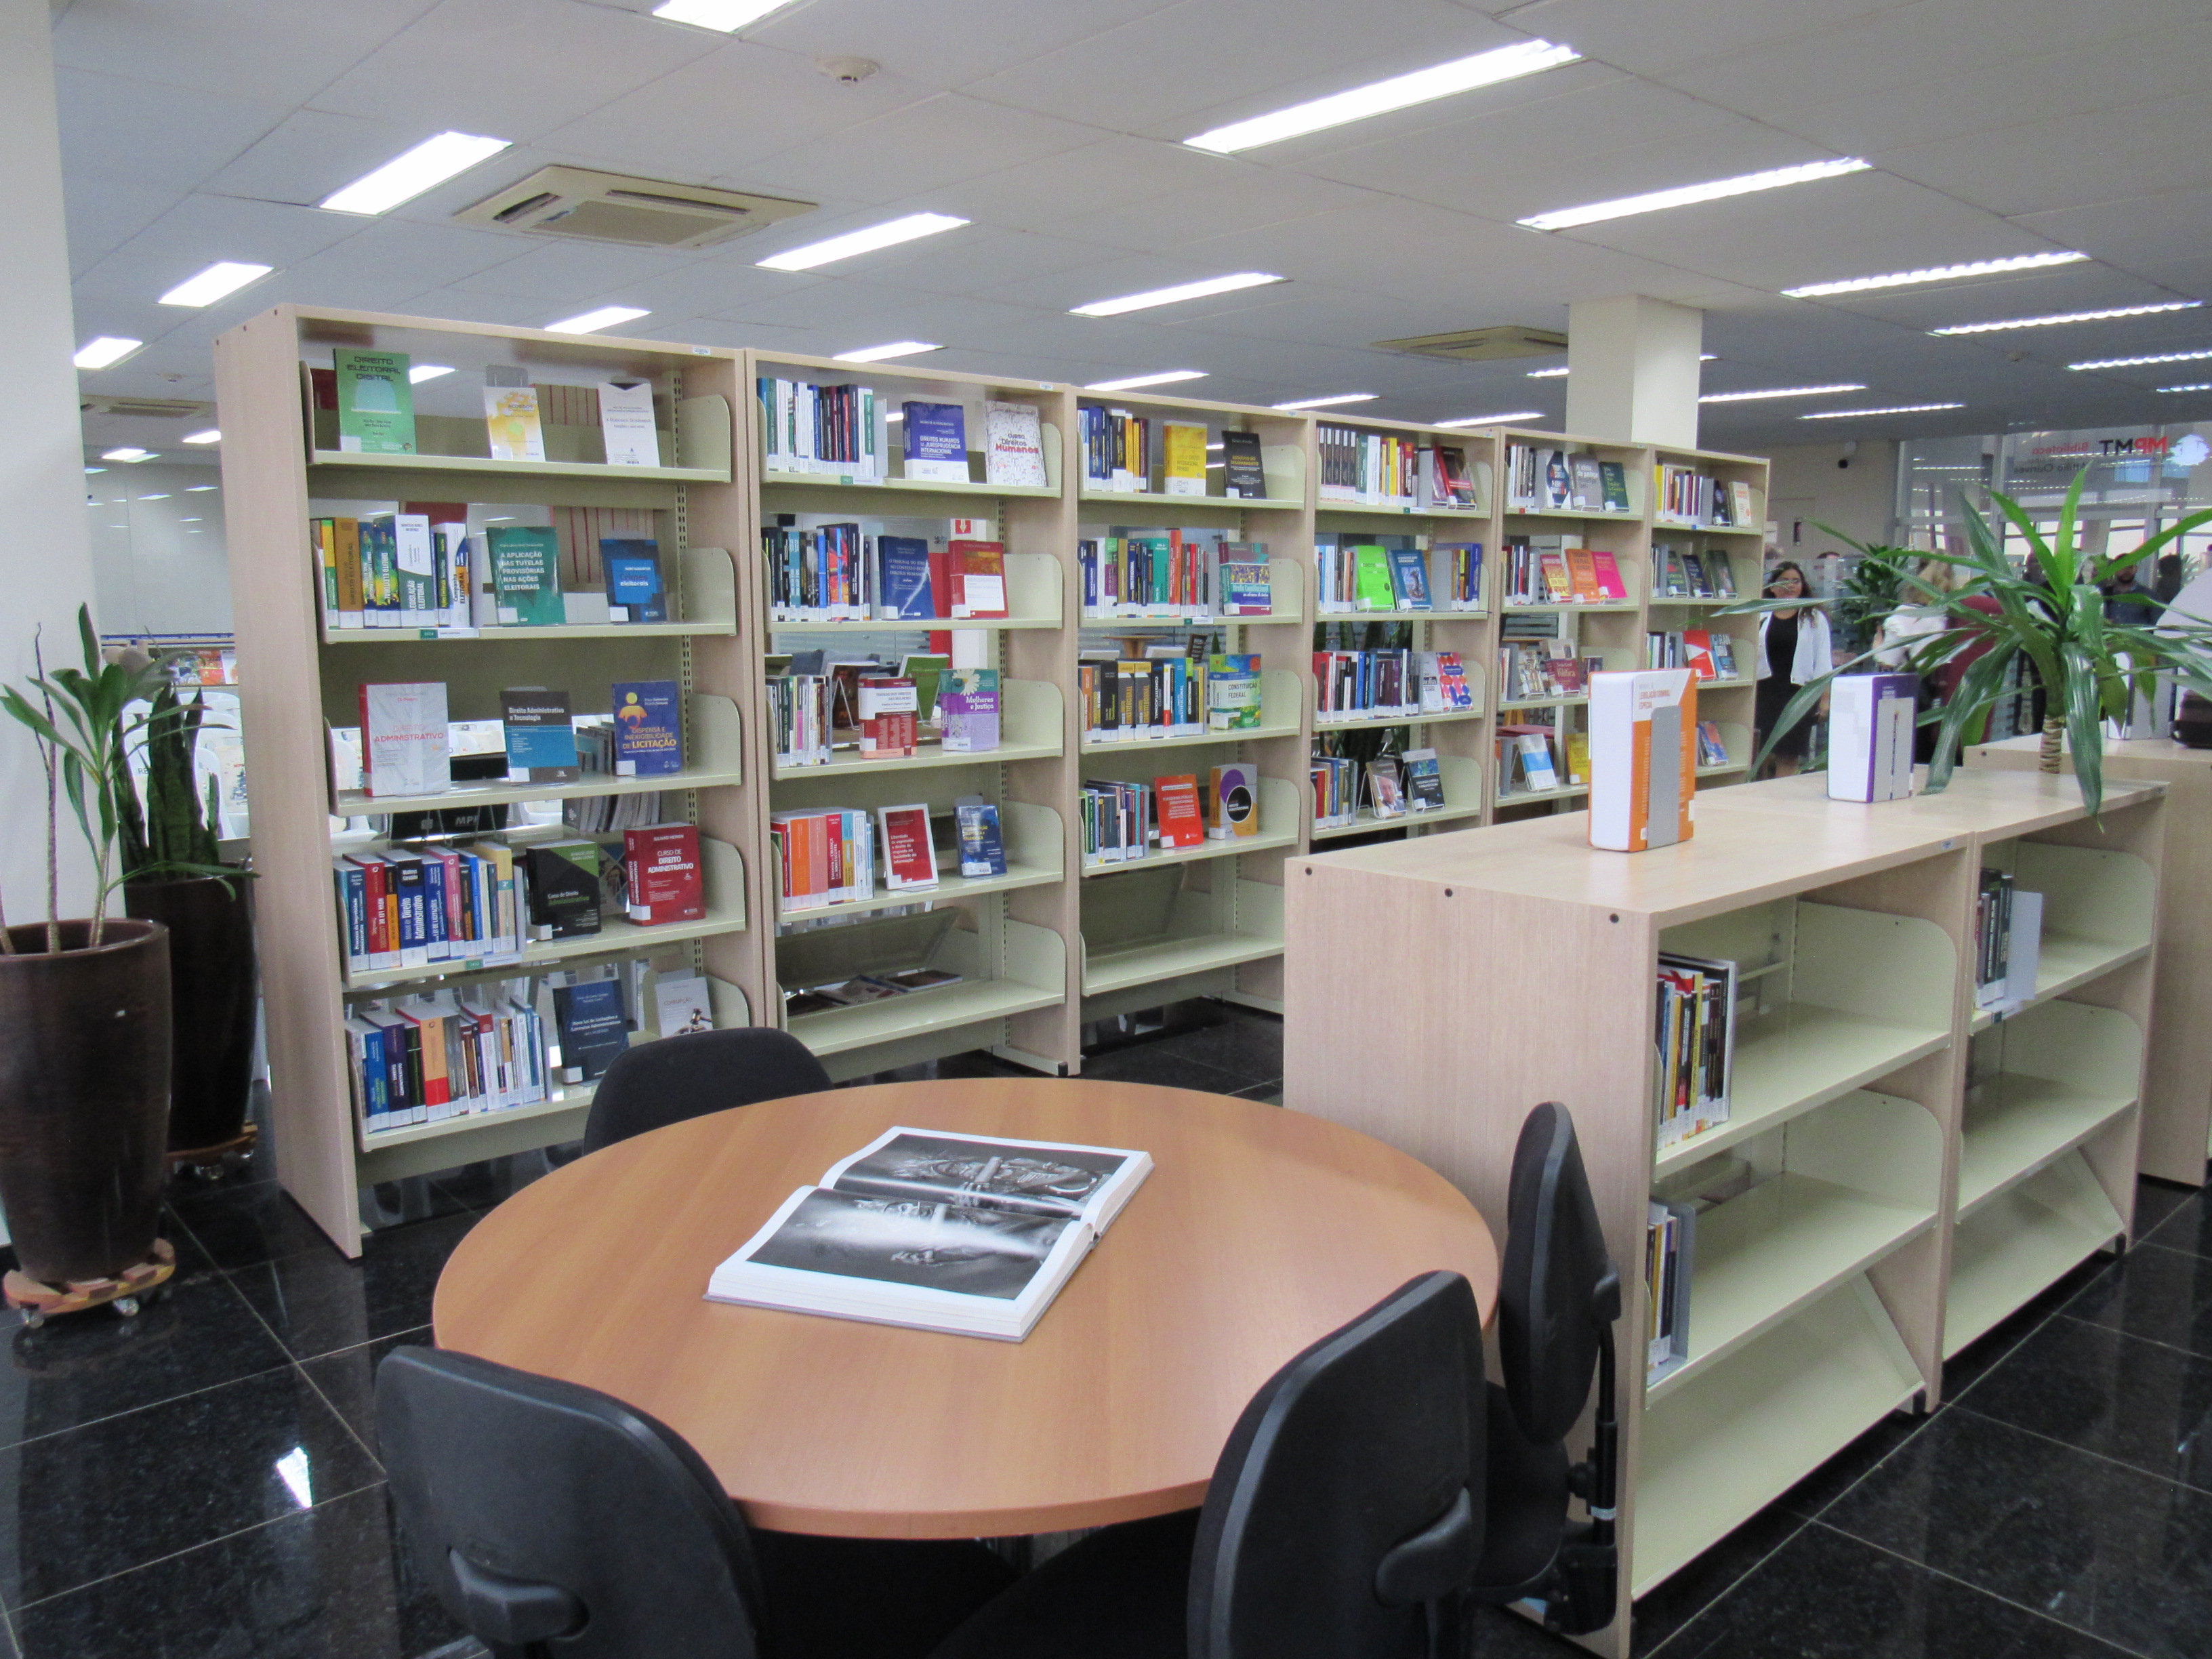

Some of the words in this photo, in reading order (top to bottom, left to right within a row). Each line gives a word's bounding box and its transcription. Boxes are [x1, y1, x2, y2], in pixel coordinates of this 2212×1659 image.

[354, 356, 394, 365] DIREITO
[346, 364, 401, 375] ELEITORAL
[356, 373, 394, 382] DIGITAL
[1001, 438, 1027, 446] Direitos
[996, 443, 1039, 454] Humanos
[506, 551, 543, 559] APLICAÇÃO
[517, 575, 539, 583] AÇÕES
[383, 573, 391, 598] ELEITORAL
[417, 581, 426, 609] ELEITORAL
[1228, 682, 1258, 690] CONSTITUIÇÃO
[966, 695, 994, 703] Mulheres
[975, 703, 994, 711] Justiça
[514, 714, 541, 722] Tecnologia
[393, 724, 426, 732] DIREITO
[632, 726, 661, 734] DISPENSA
[373, 732, 445, 743] ADMINISTRATIVO
[623, 732, 674, 741] INEXIGIBILIDADE
[632, 737, 677, 749] LICITAÇÃO
[658, 855, 682, 865] DIREITO
[647, 862, 694, 874] ADMINISTRATIVO
[401, 897, 411, 920] Direito
[413, 894, 426, 939] Administrativo
[663, 997, 693, 1006] CORRUPÇÃO
